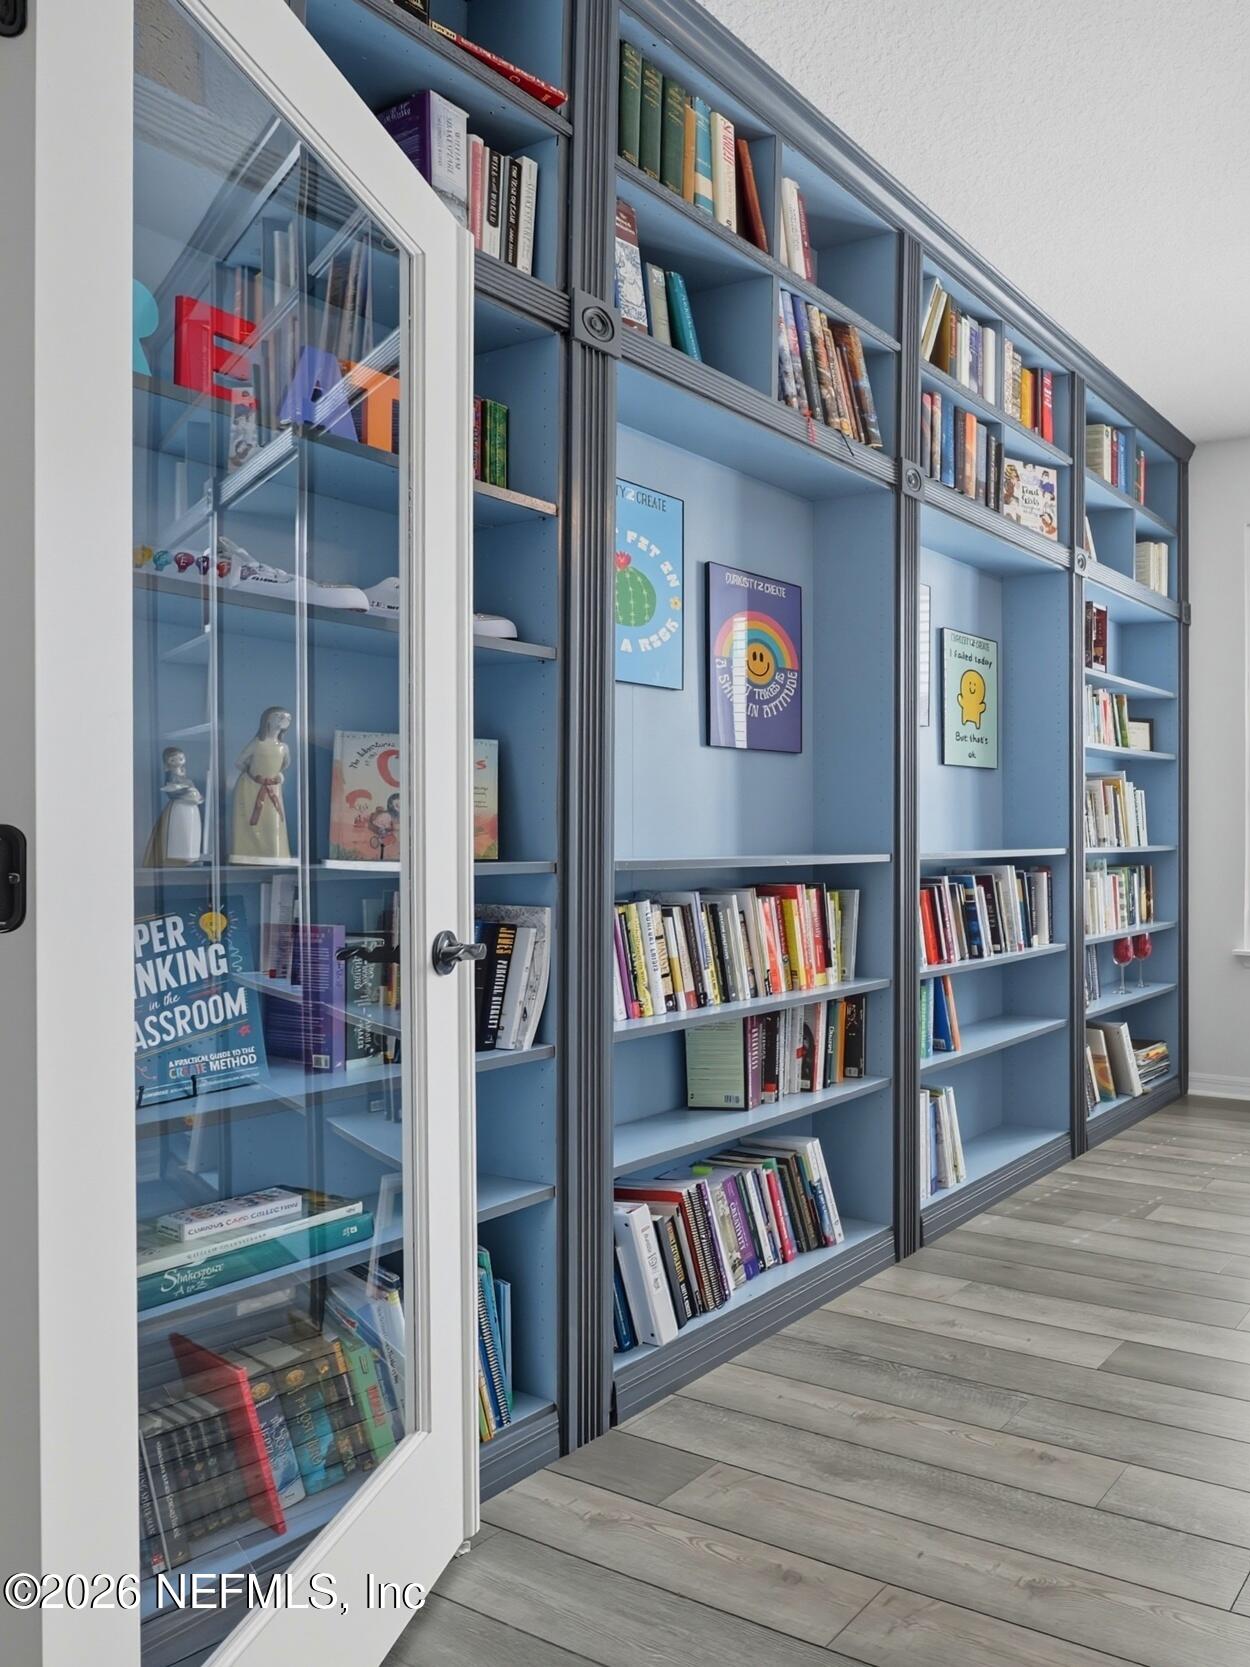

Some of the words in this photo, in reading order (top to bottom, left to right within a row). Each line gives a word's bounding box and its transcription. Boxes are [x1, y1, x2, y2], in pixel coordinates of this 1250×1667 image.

[953, 649, 973, 662] failed
[955, 731, 968, 743] But
[134, 915, 187, 957] PER
[495, 927, 516, 954] JAMES
[134, 943, 229, 1000] NKING
[164, 991, 181, 1004] the
[134, 987, 248, 1053] ASSROOM
[174, 1055, 209, 1067] PRACTICAL
[209, 1054, 257, 1072] METHOD
[187, 1221, 224, 1236] CURIOUS
